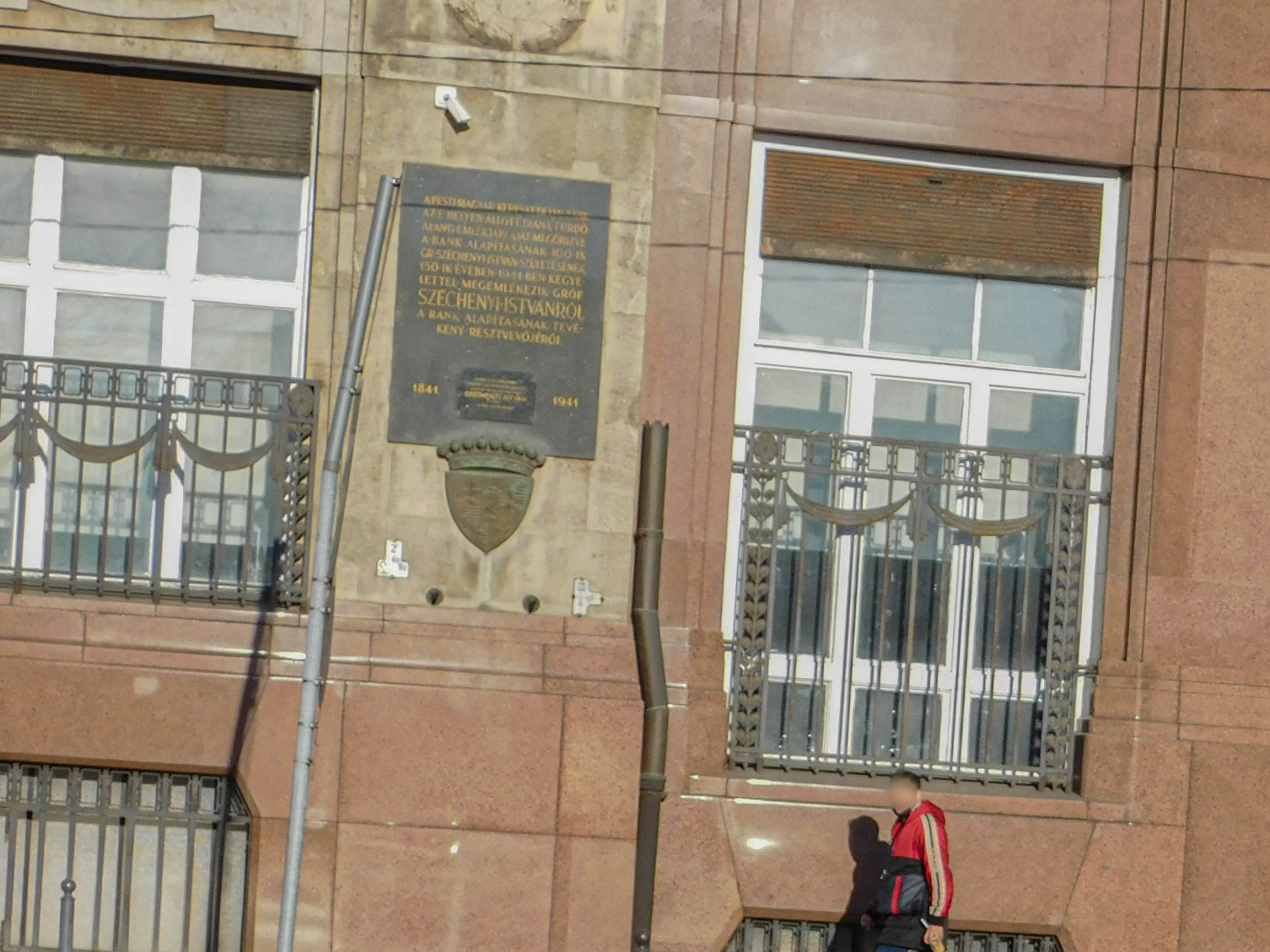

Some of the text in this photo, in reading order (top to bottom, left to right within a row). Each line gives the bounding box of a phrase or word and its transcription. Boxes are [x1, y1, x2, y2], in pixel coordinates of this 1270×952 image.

[420, 234, 428, 245] A
[431, 235, 462, 248] BANK
[418, 274, 457, 288] LETTEL
[416, 307, 424, 318] A
[428, 309, 460, 322] BANK
[412, 382, 439, 395] 1841
[552, 396, 579, 408] 1941
